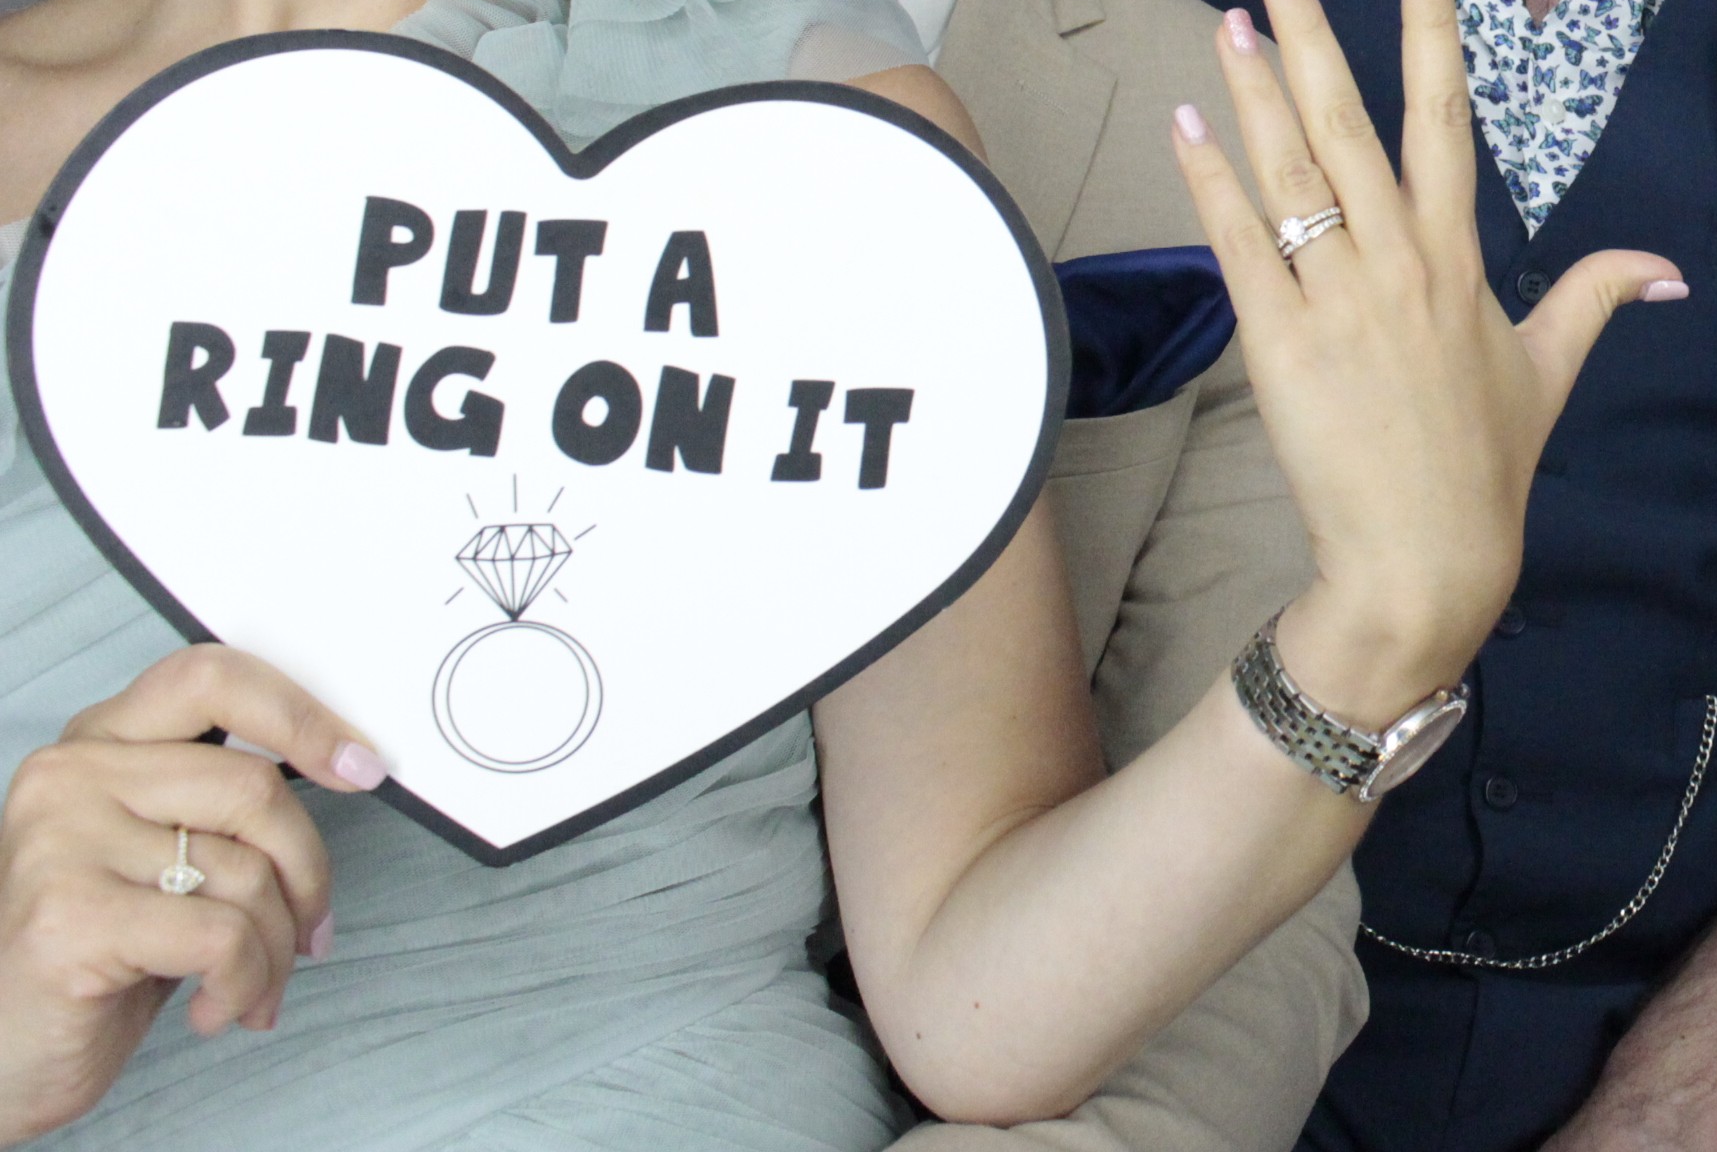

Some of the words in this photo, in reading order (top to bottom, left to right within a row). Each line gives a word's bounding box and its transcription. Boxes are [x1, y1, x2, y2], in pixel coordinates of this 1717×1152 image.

[351, 196, 607, 323] PUT
[644, 230, 719, 337] A
[157, 321, 504, 457] RING
[552, 360, 735, 475] ON
[770, 379, 914, 490] IT
